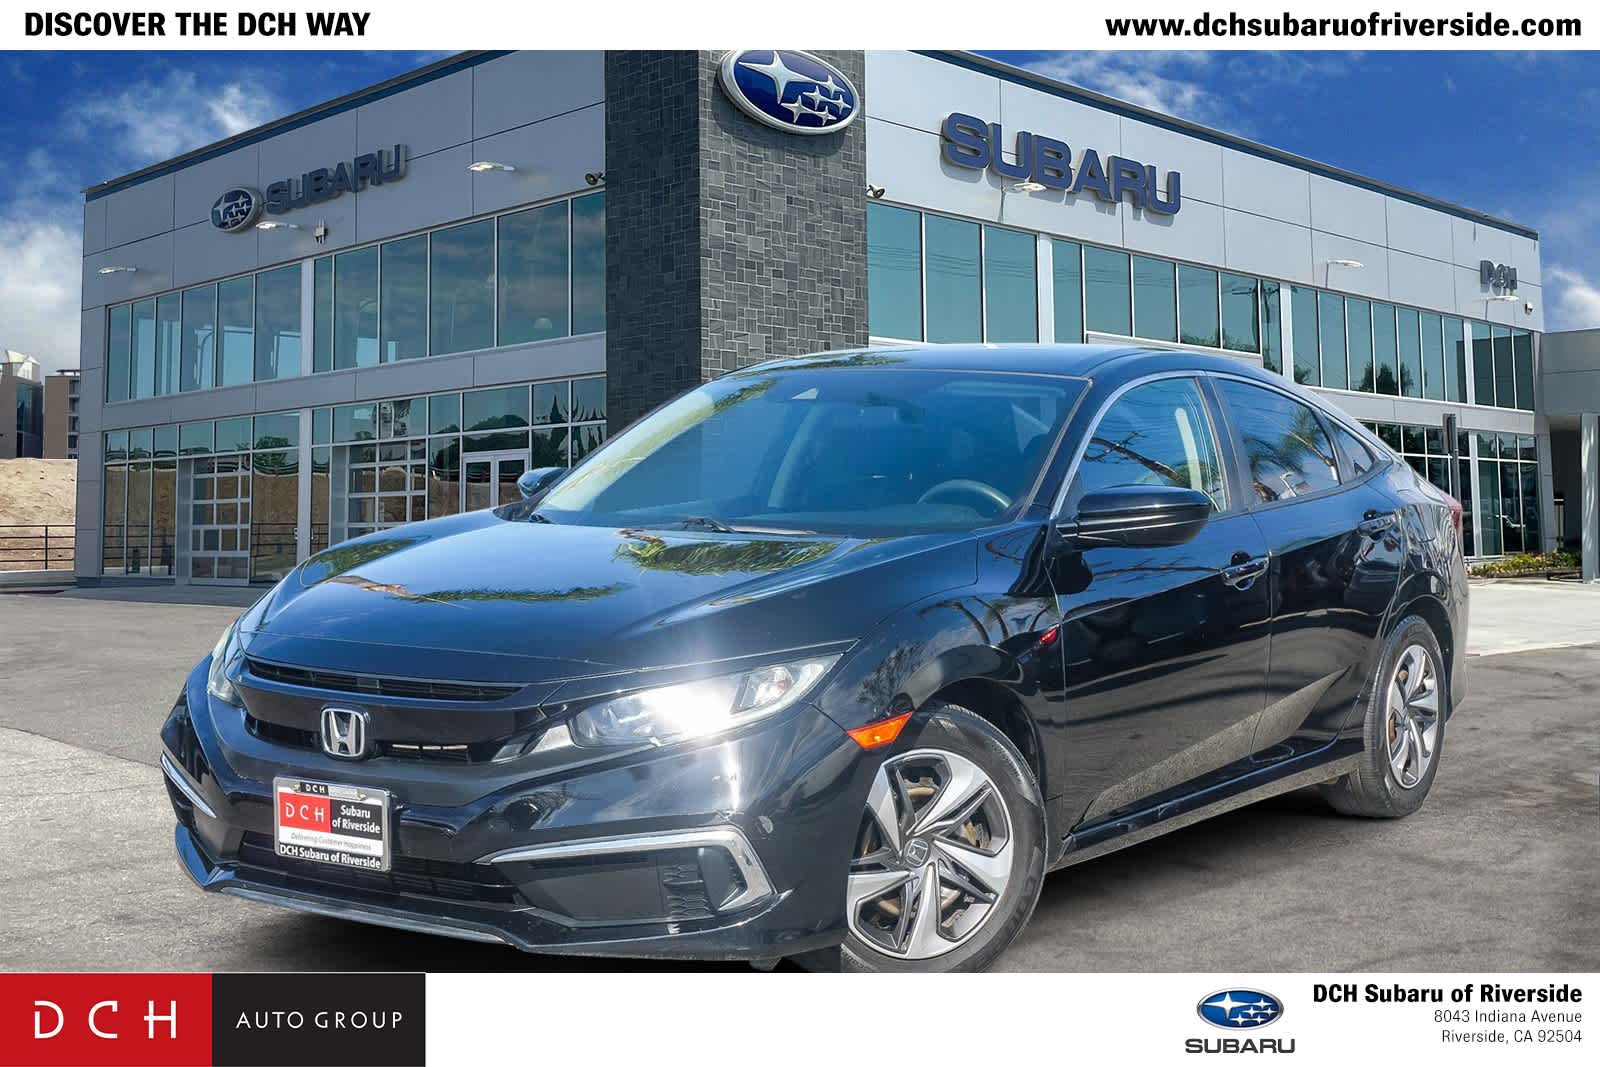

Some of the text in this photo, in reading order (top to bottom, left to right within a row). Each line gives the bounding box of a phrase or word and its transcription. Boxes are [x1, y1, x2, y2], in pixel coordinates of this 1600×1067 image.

[942, 112, 1181, 215] SUBARU
[266, 144, 407, 214] SUBARU
[305, 783, 325, 793] DCH
[285, 802, 325, 823] DCH
[341, 805, 370, 818] Subaru
[332, 818, 381, 833] of Riverside
[280, 844, 381, 868] DCH Subaru of Riverside
